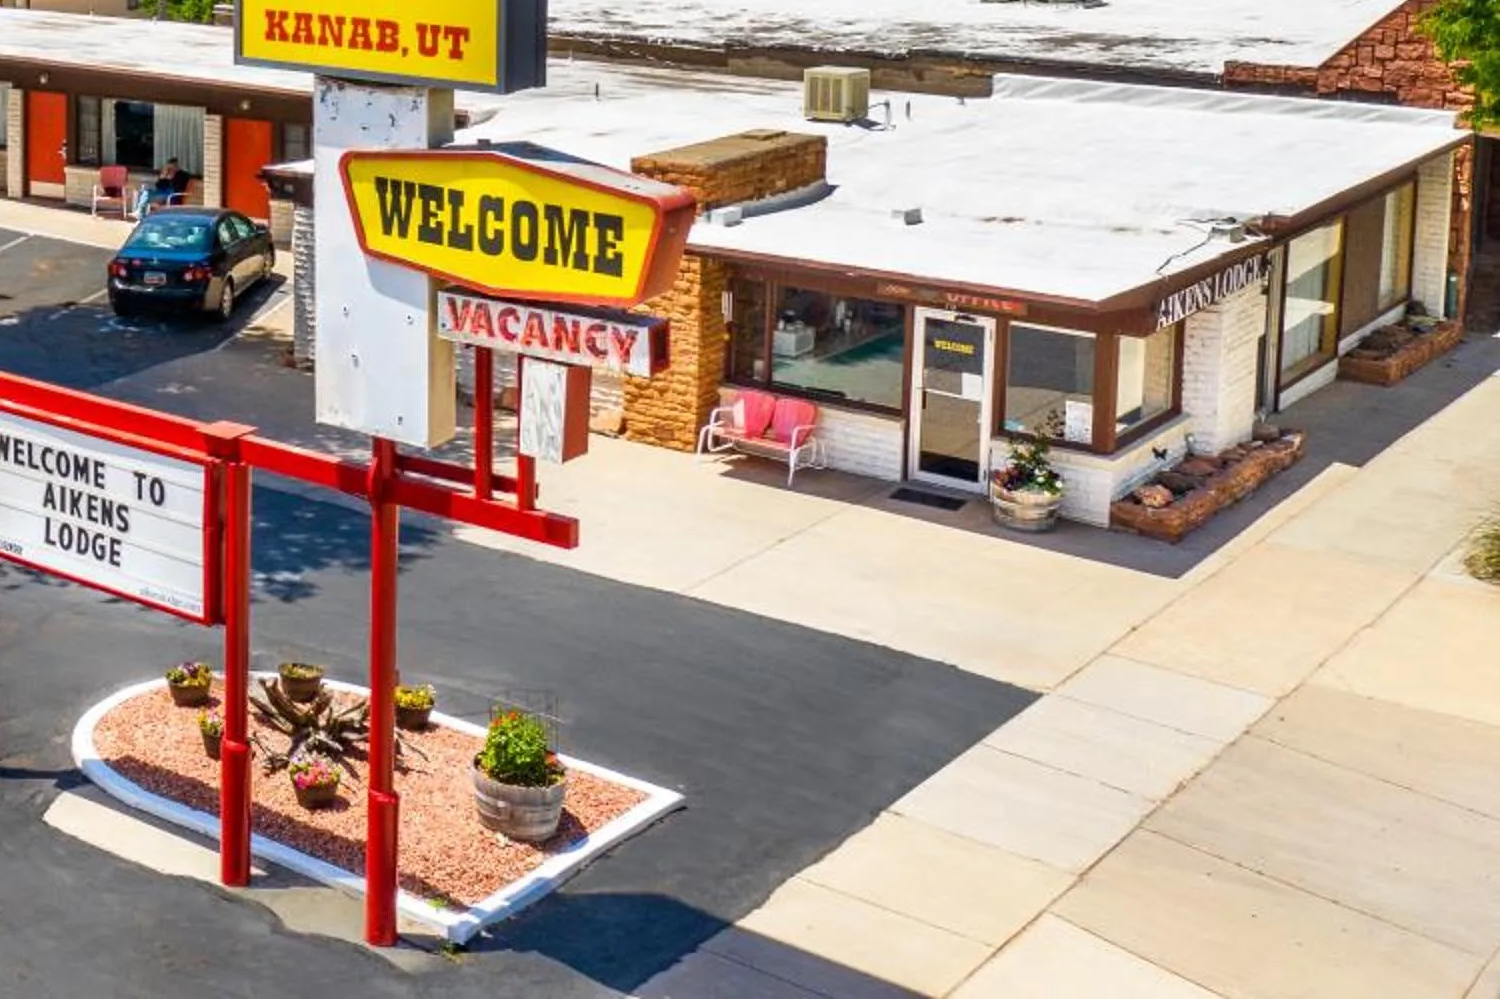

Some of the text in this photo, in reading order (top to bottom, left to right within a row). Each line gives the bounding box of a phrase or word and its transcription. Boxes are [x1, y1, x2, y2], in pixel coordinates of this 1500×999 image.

[374, 176, 625, 279] WELCOME
[1156, 255, 1261, 331] AIKENS LODGE
[446, 296, 639, 364] VACANCY
[934, 339, 975, 355] WELCOME
[43, 482, 130, 533] AIKENS
[133, 471, 166, 507] TO
[45, 517, 122, 568] LODGE
